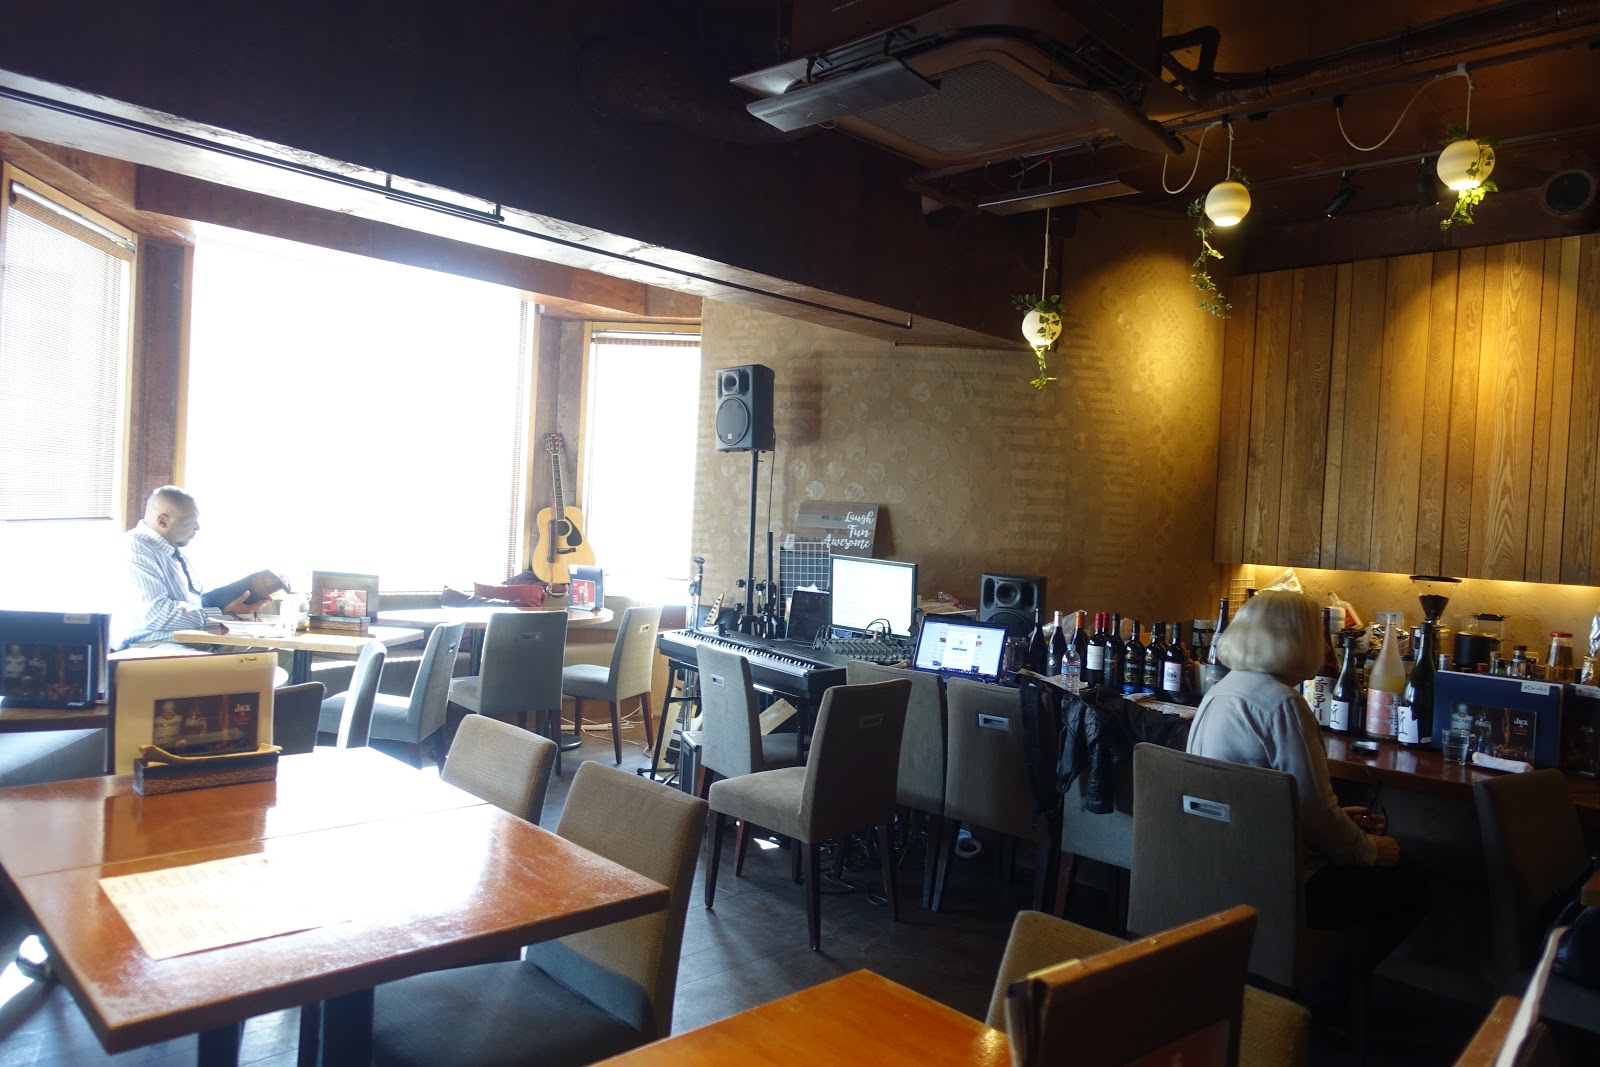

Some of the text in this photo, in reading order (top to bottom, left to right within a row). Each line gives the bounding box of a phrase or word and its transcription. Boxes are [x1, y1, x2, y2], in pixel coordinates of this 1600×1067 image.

[845, 511, 874, 524] Laugh
[847, 524, 870, 538] Fun
[821, 534, 870, 549] Awesome
